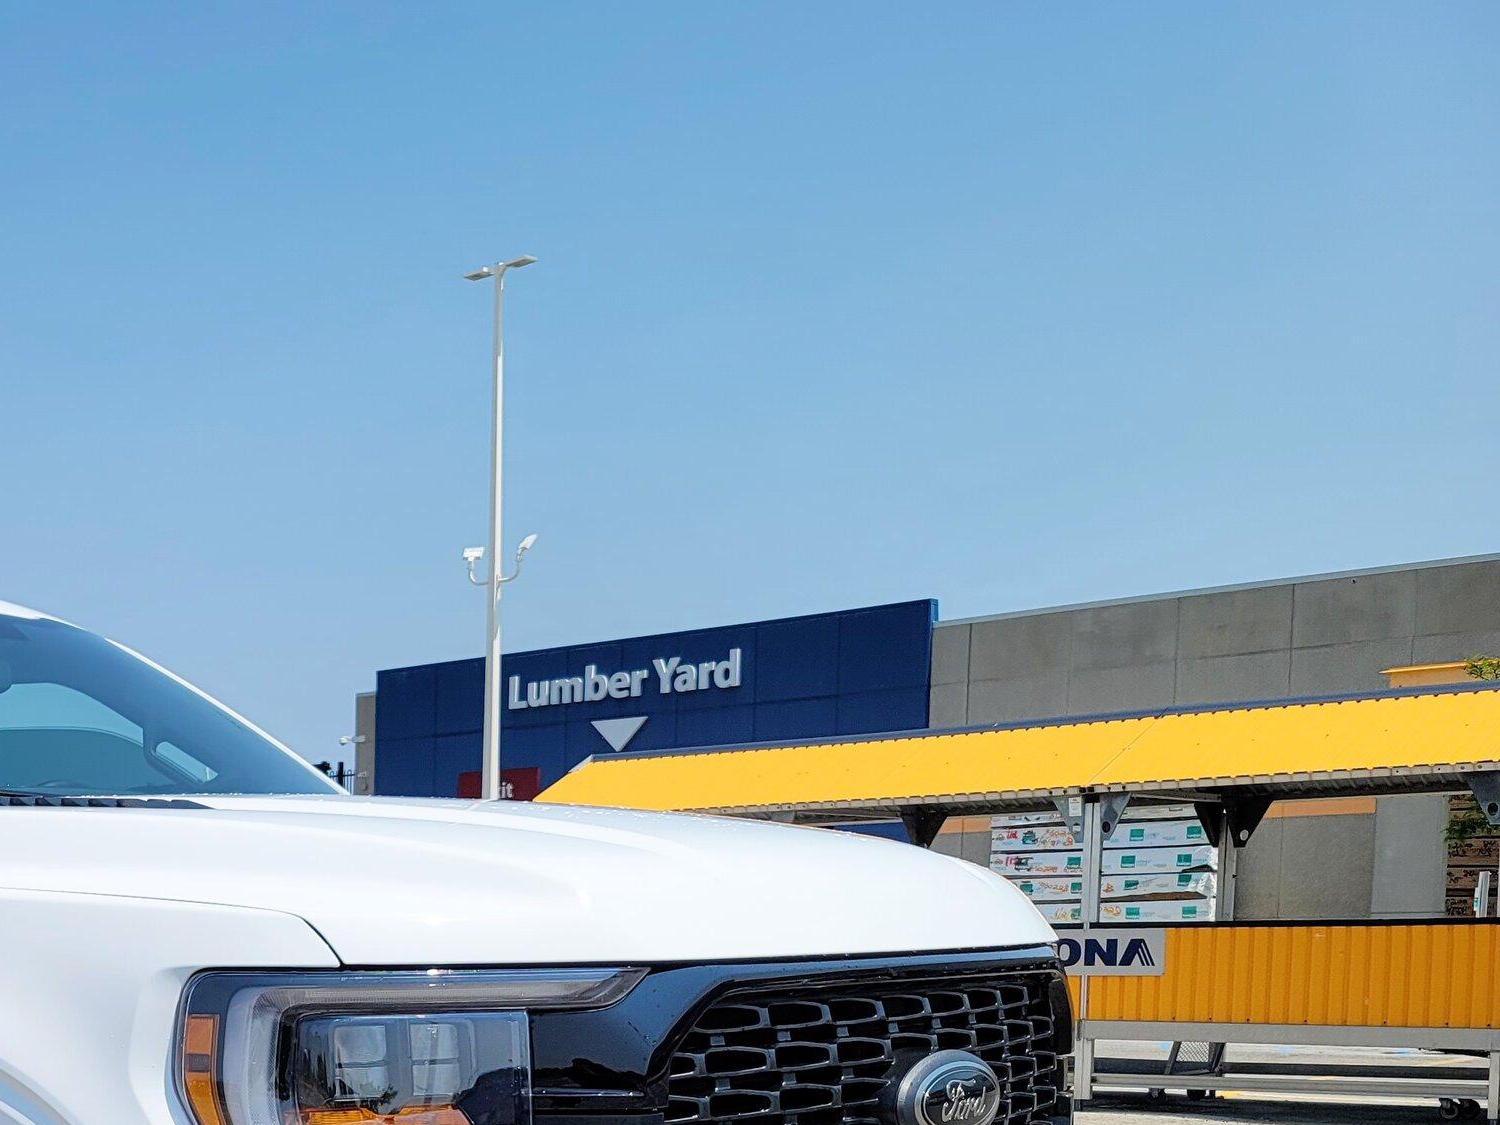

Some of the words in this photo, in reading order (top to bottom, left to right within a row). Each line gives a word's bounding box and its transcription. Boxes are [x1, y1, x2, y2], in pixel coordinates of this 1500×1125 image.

[508, 664, 649, 710] Lumber
[652, 647, 742, 694] Yard
[1056, 937, 1155, 967] ONA
[941, 1079, 986, 1122] Ford
